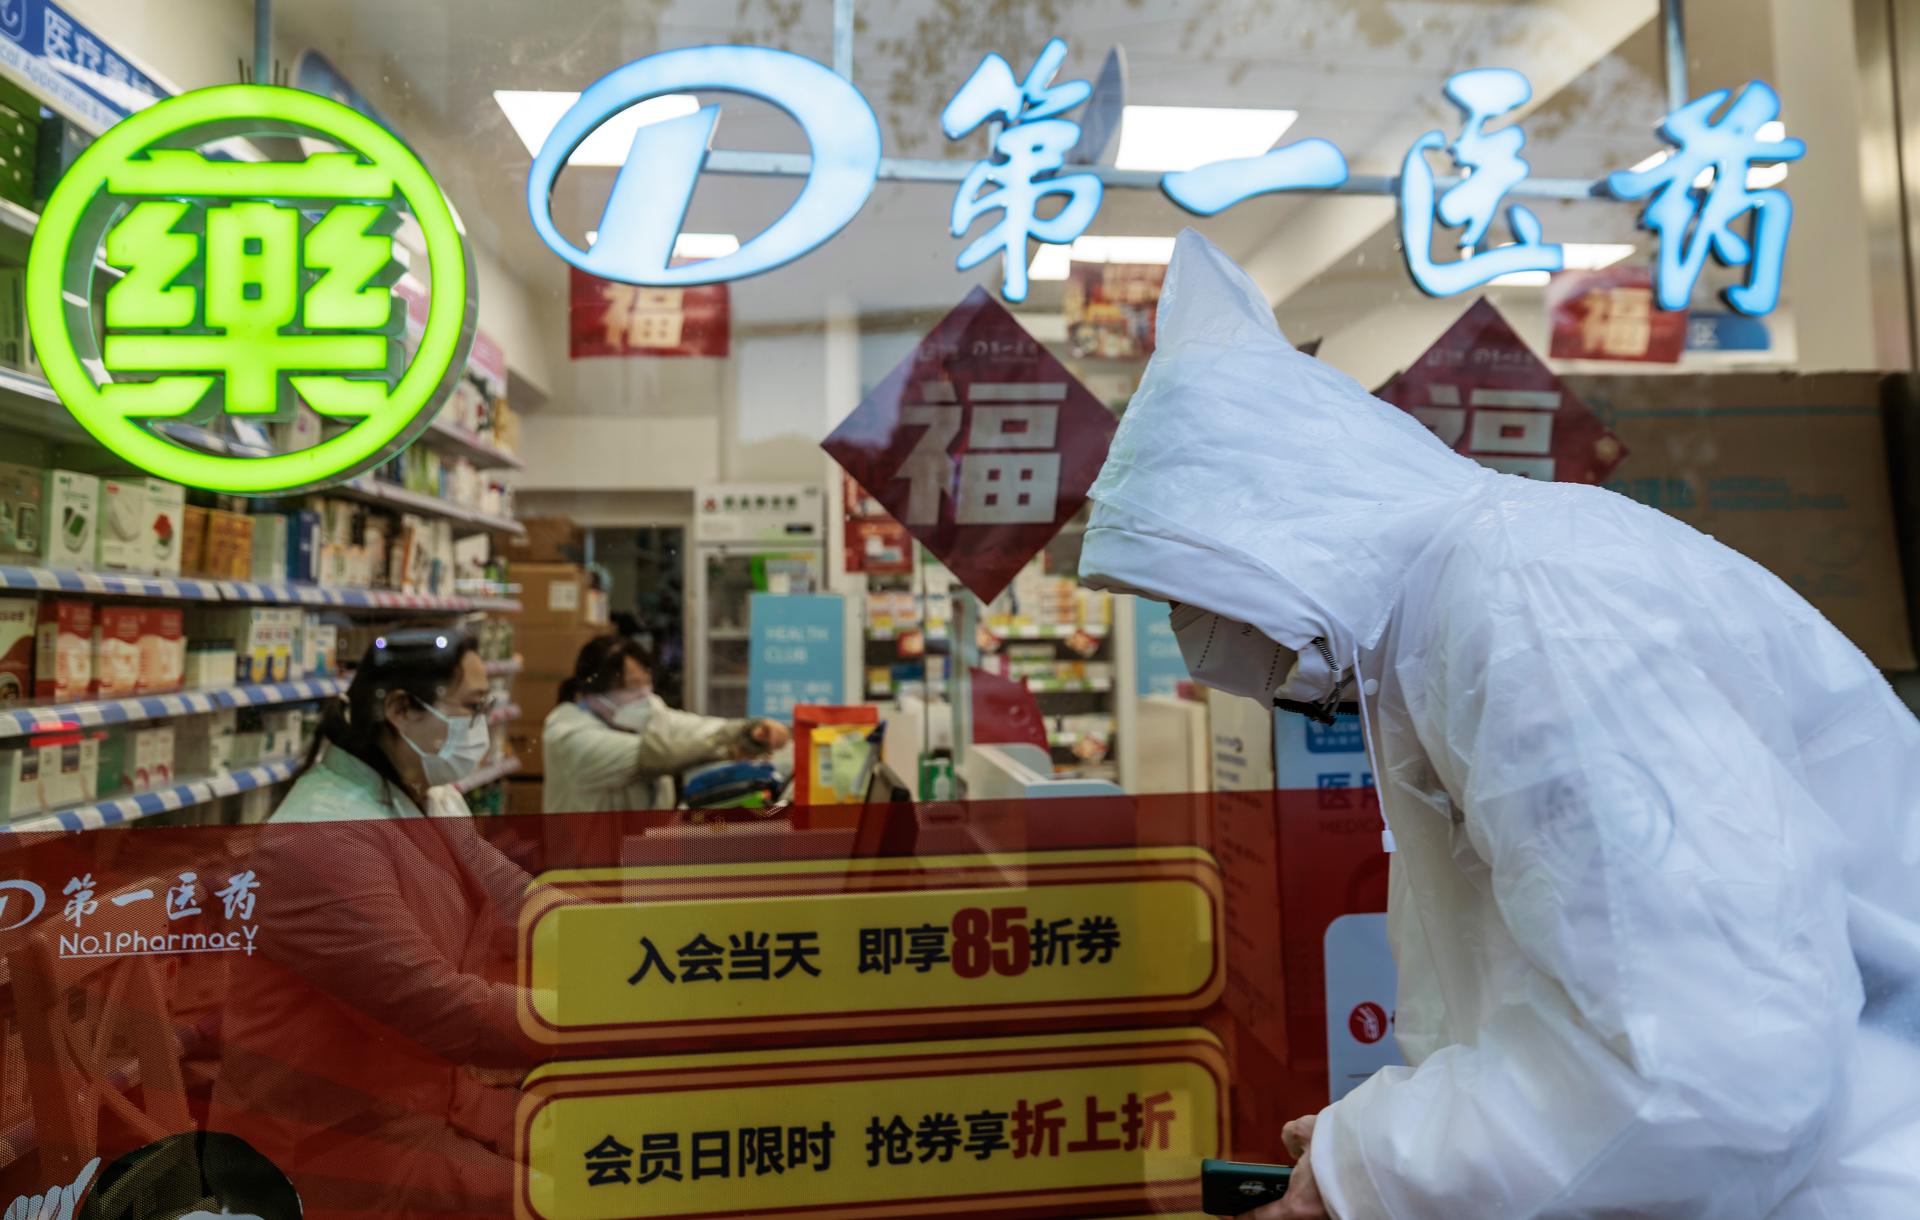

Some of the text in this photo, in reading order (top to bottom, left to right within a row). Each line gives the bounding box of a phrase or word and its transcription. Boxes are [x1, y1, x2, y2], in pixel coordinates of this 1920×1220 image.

[940, 37, 1807, 317] 第一医药
[602, 283, 685, 351] 福
[1582, 286, 1652, 356] 福
[893, 381, 1068, 526] 福
[62, 870, 260, 928] 第一医药
[627, 906, 1122, 986] 入会当天 即享85折券
[583, 1091, 1178, 1188] 会员日限时 抢券享折上折
